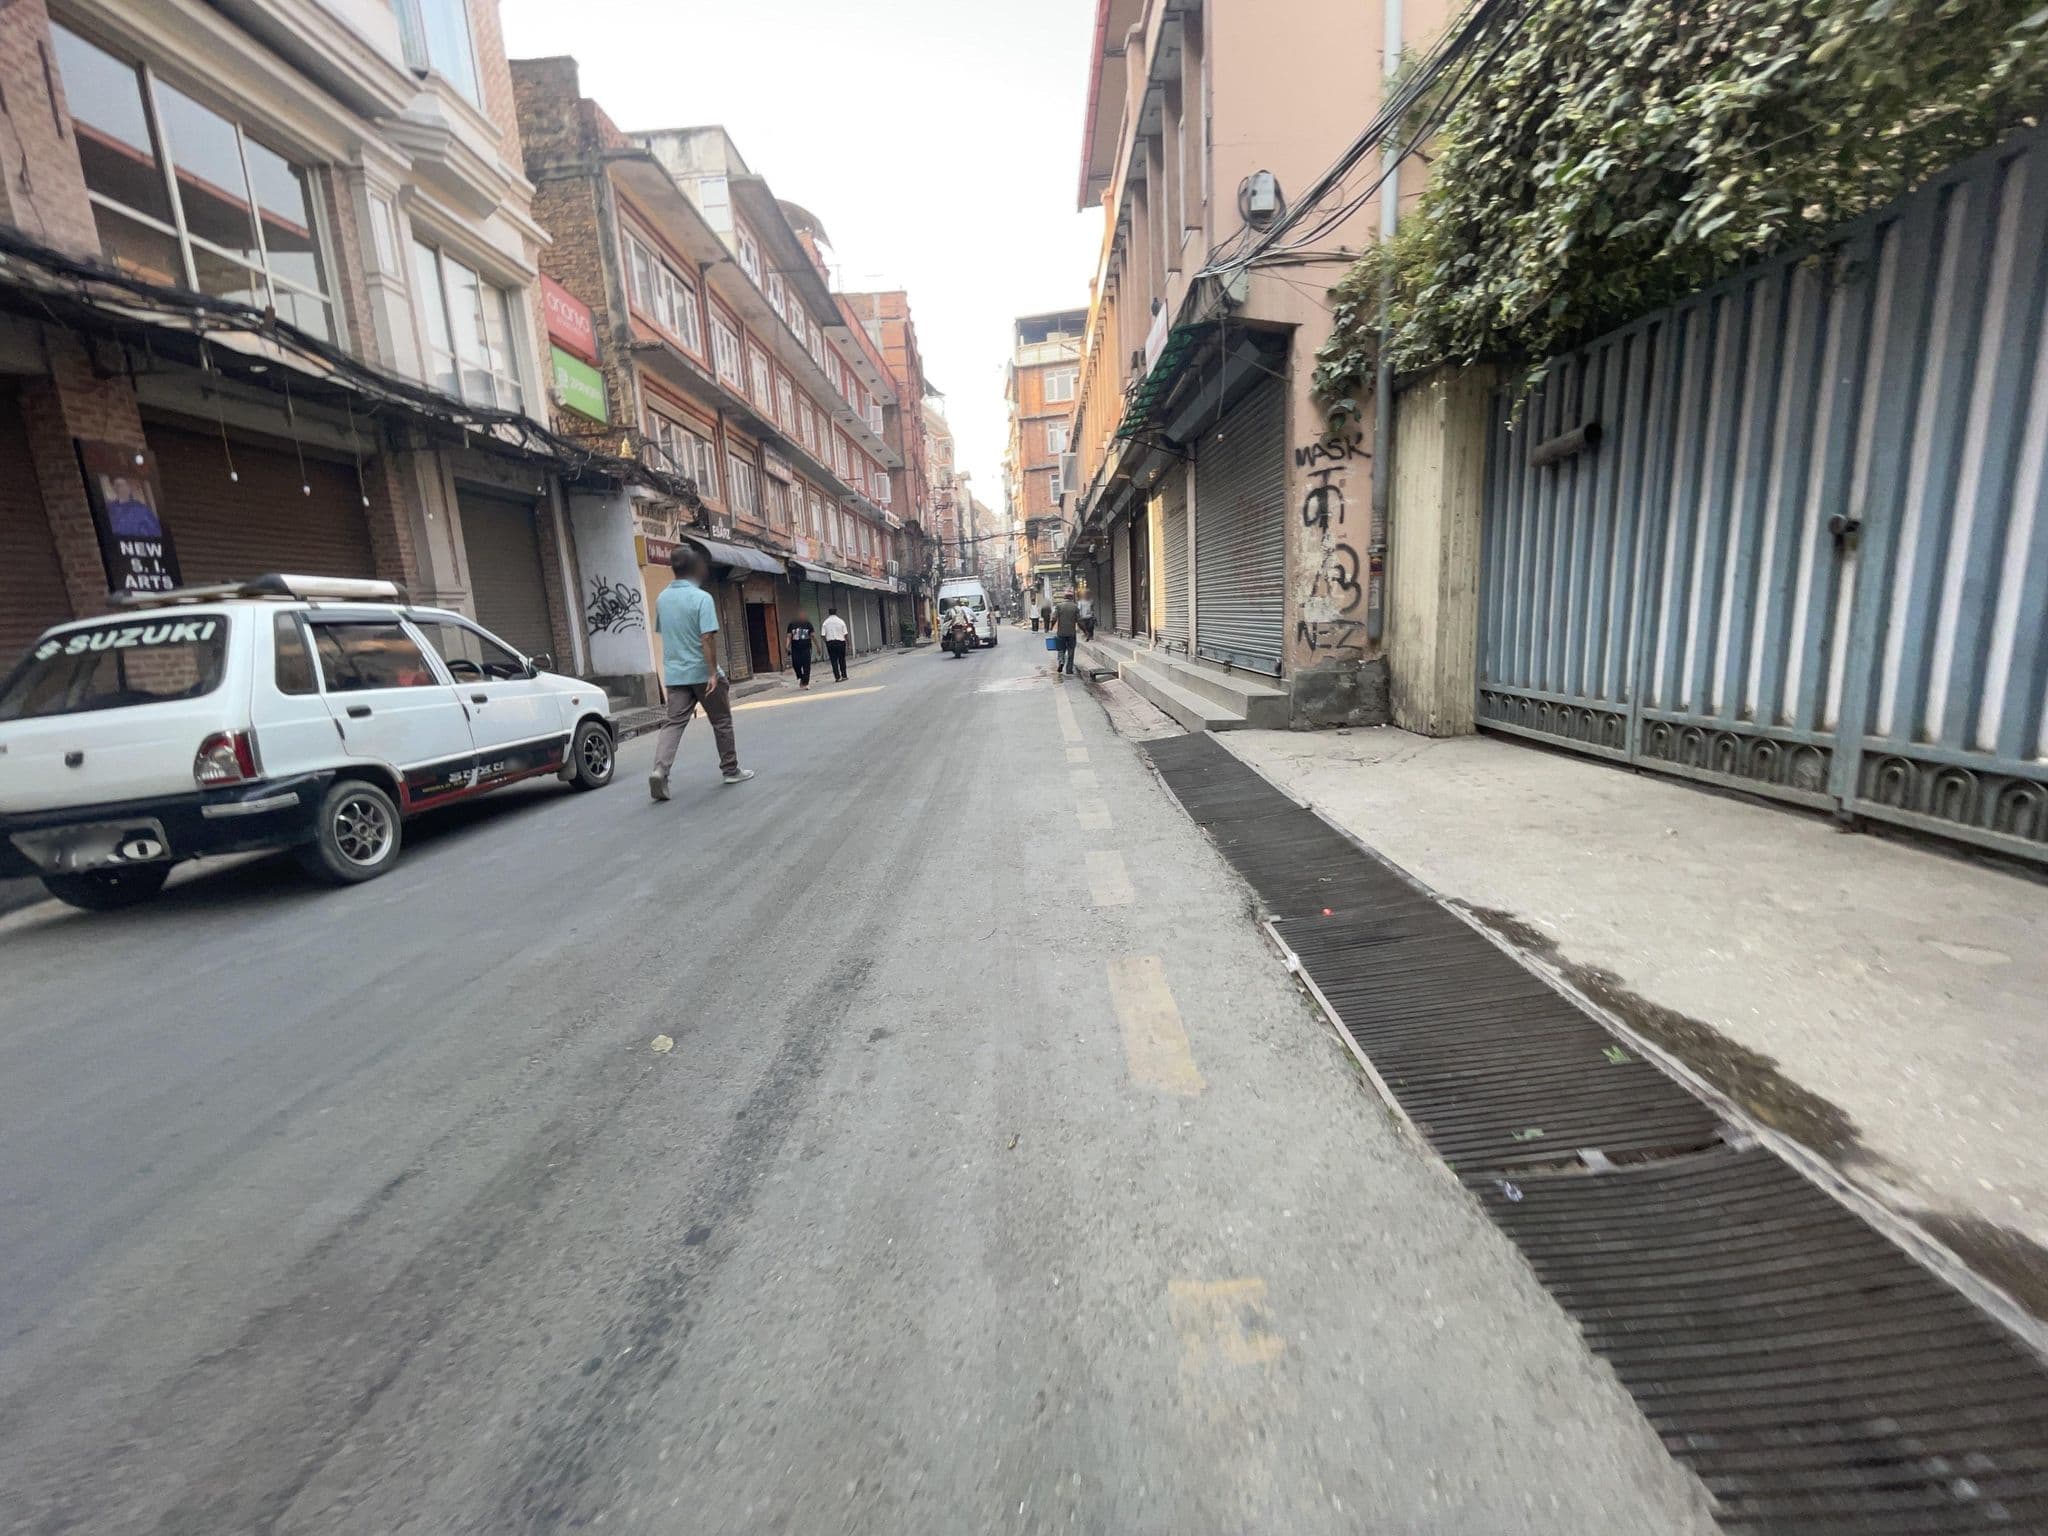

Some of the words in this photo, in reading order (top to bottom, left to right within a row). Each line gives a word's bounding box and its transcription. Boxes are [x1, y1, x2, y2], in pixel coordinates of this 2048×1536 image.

[120, 540, 162, 558] NEW
[125, 574, 174, 590] ARTS
[64, 621, 217, 656] SUZUKI
